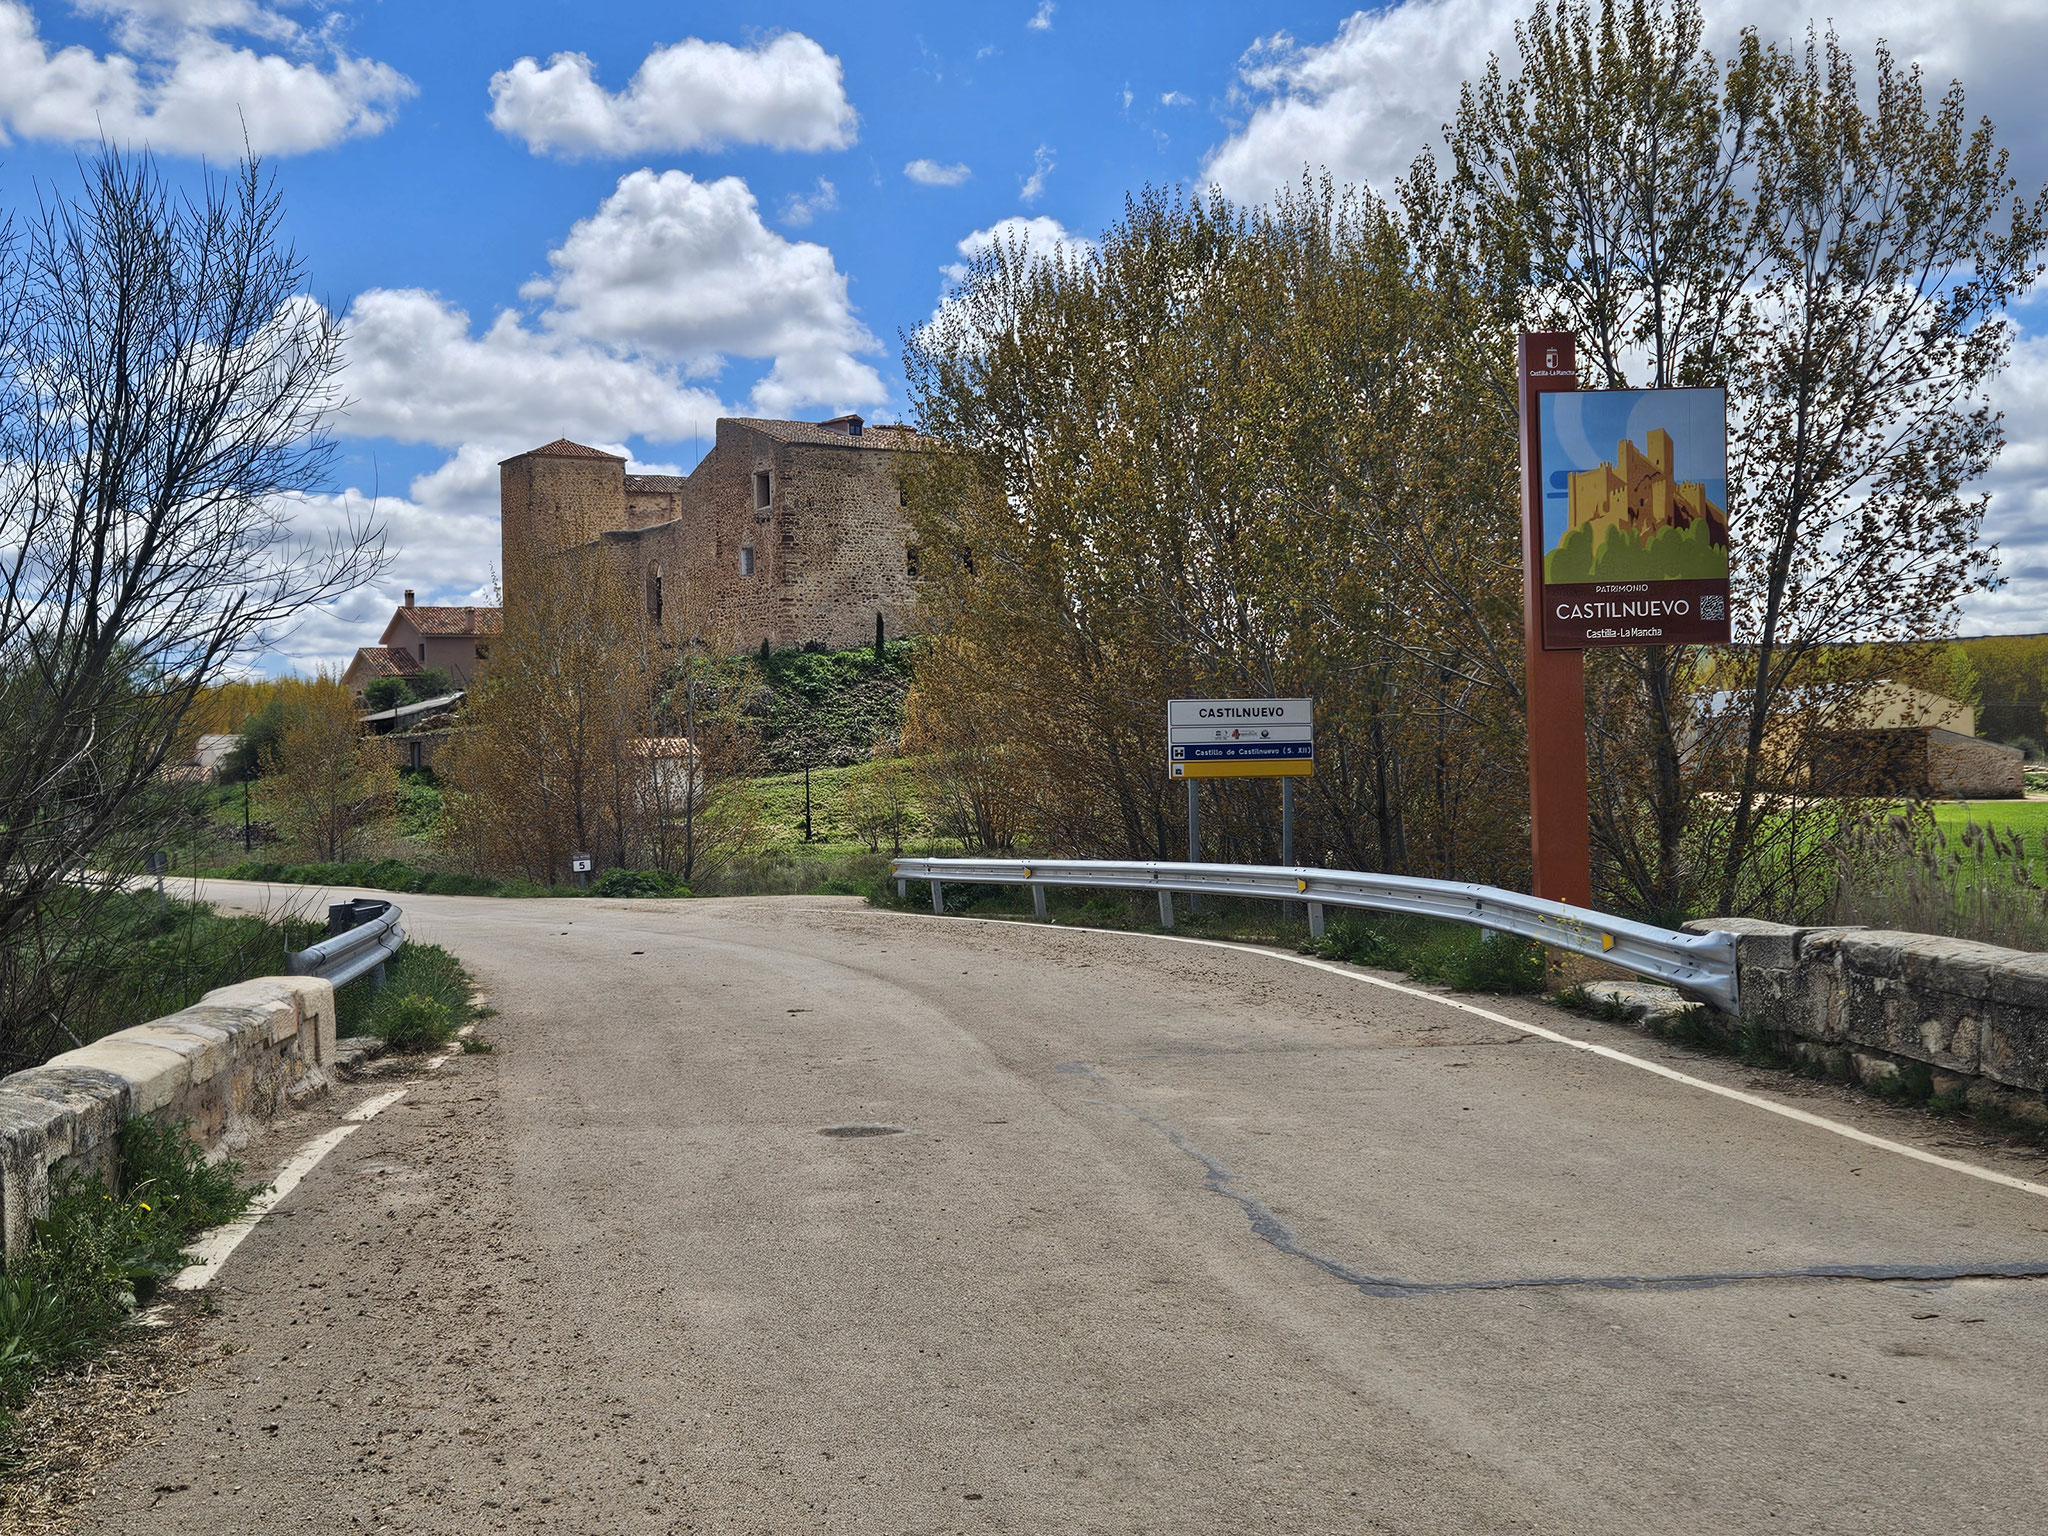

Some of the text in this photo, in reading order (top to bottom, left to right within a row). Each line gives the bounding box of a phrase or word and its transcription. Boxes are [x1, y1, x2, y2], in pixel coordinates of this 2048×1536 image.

[1596, 584, 1648, 593] PATRIMONIO
[1556, 600, 1690, 620] CASTILNUEVO
[1631, 627, 1662, 637] Mancha
[1199, 707, 1284, 718] CASTILNUEVO
[1282, 746, 1294, 754] (S.
